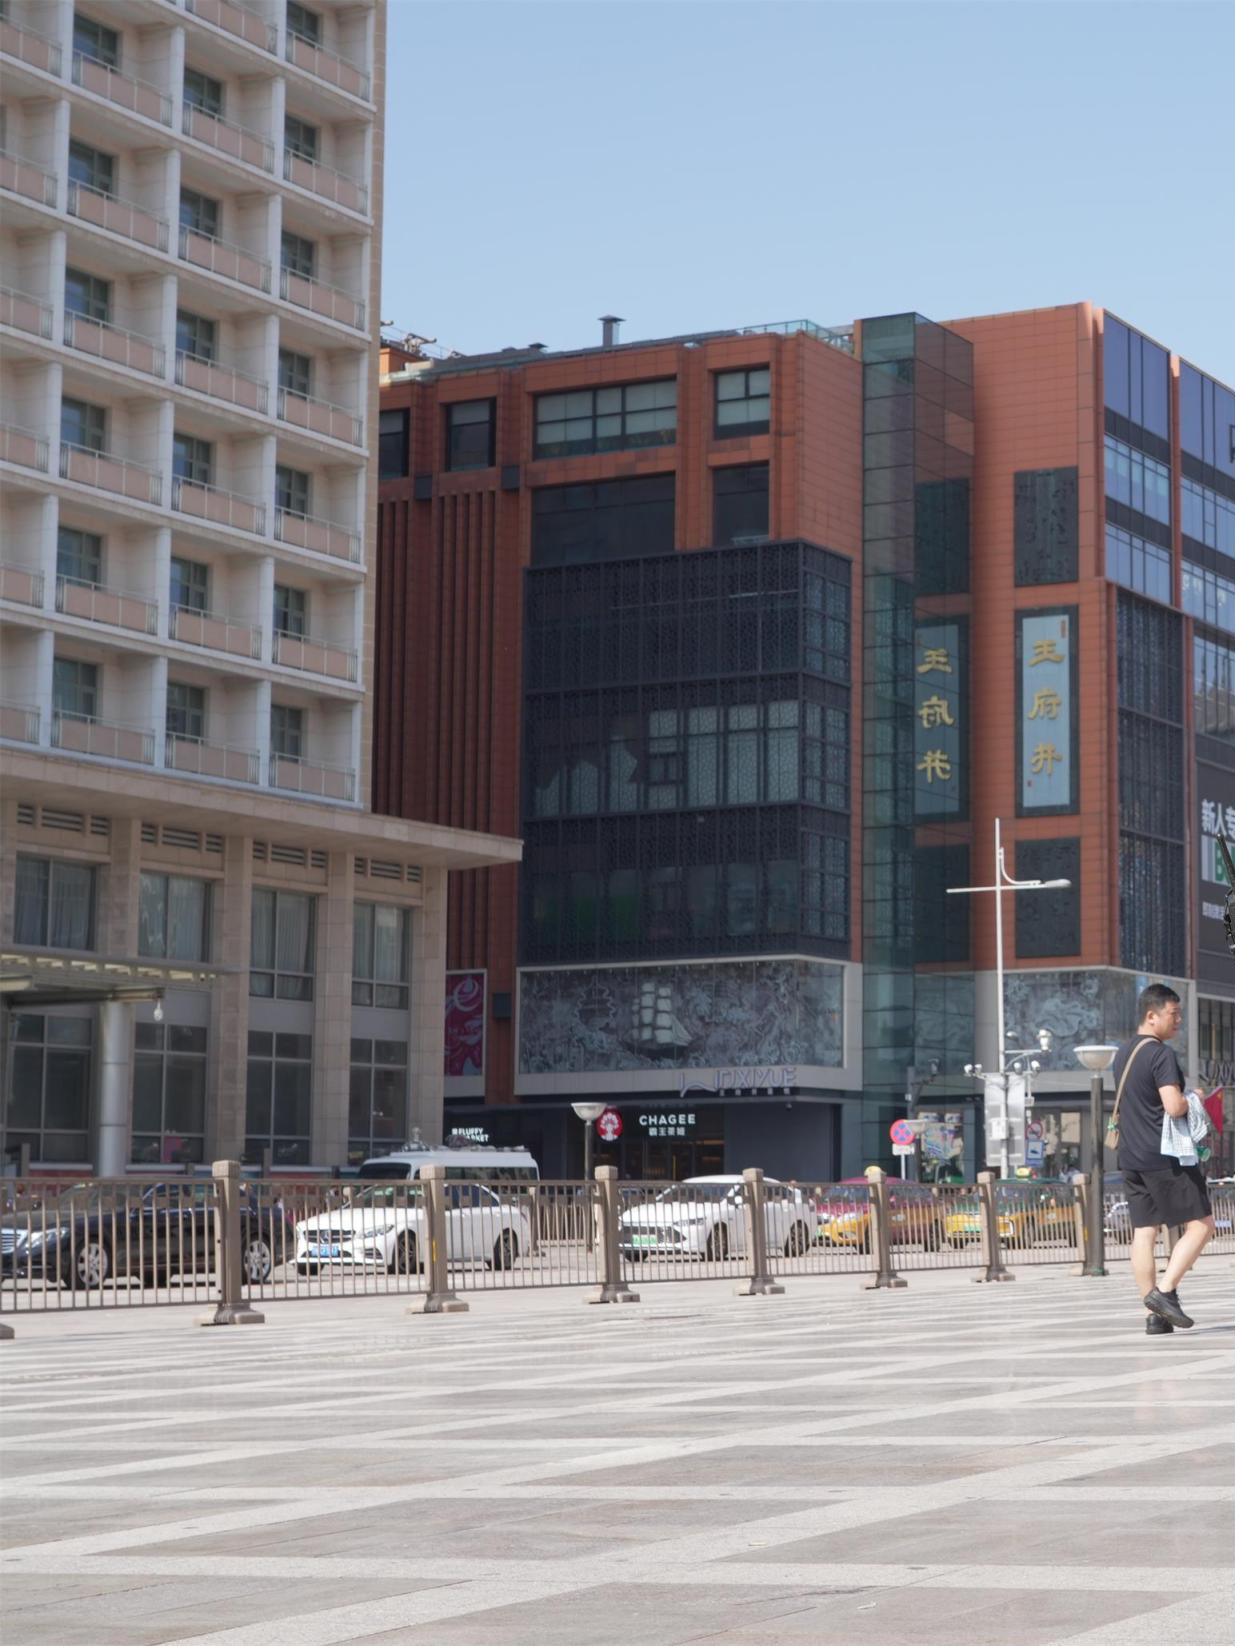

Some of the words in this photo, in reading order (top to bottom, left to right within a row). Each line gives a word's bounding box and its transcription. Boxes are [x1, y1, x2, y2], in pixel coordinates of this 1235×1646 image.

[1027, 640, 1065, 777] 王府井
[639, 1113, 696, 1127] CHAGEE
